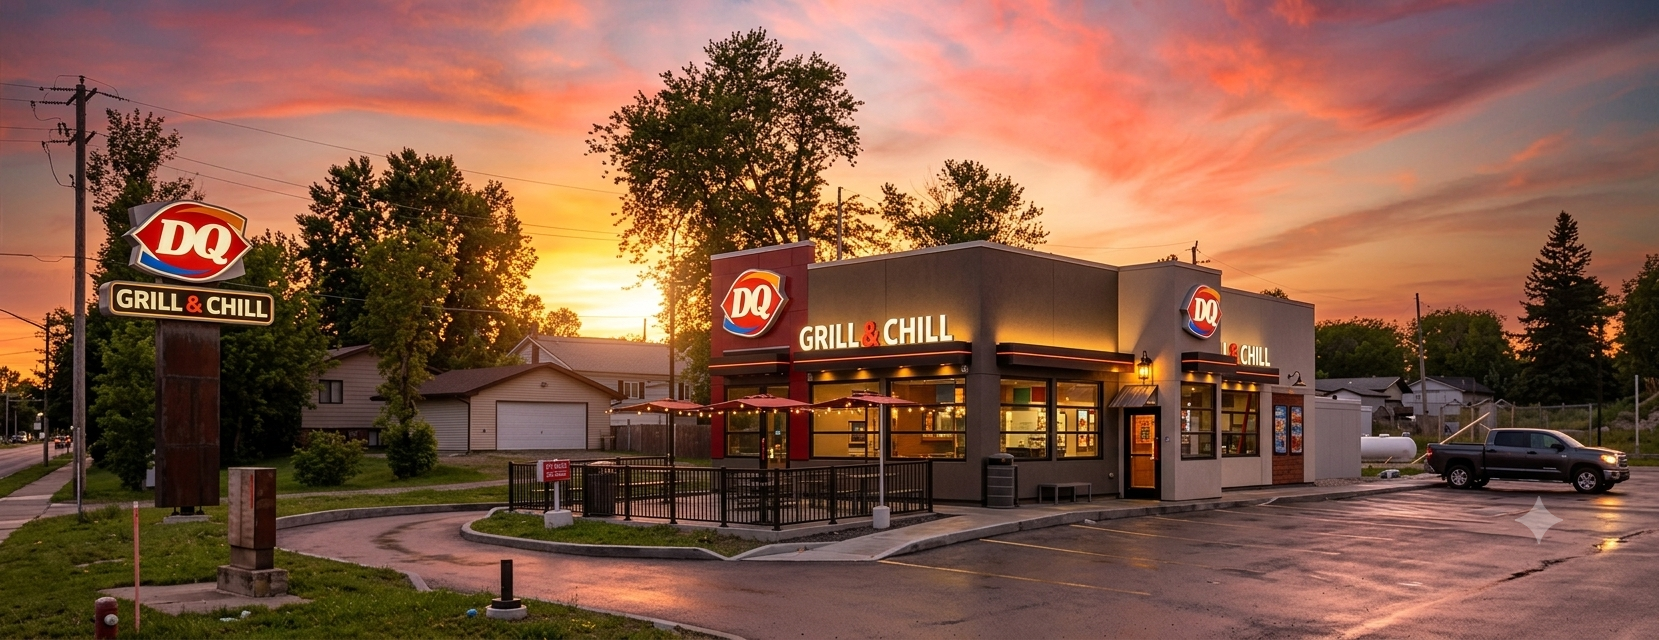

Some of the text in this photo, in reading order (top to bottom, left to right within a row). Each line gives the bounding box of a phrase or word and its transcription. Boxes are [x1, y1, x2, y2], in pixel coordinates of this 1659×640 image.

[155, 218, 232, 265] DQ
[116, 289, 268, 319] GRILL & CHILL
[730, 284, 772, 320] DQ
[1193, 297, 1218, 327] DQ
[799, 314, 954, 351] GRILL & CHILL
[1240, 344, 1271, 367] CHILL
